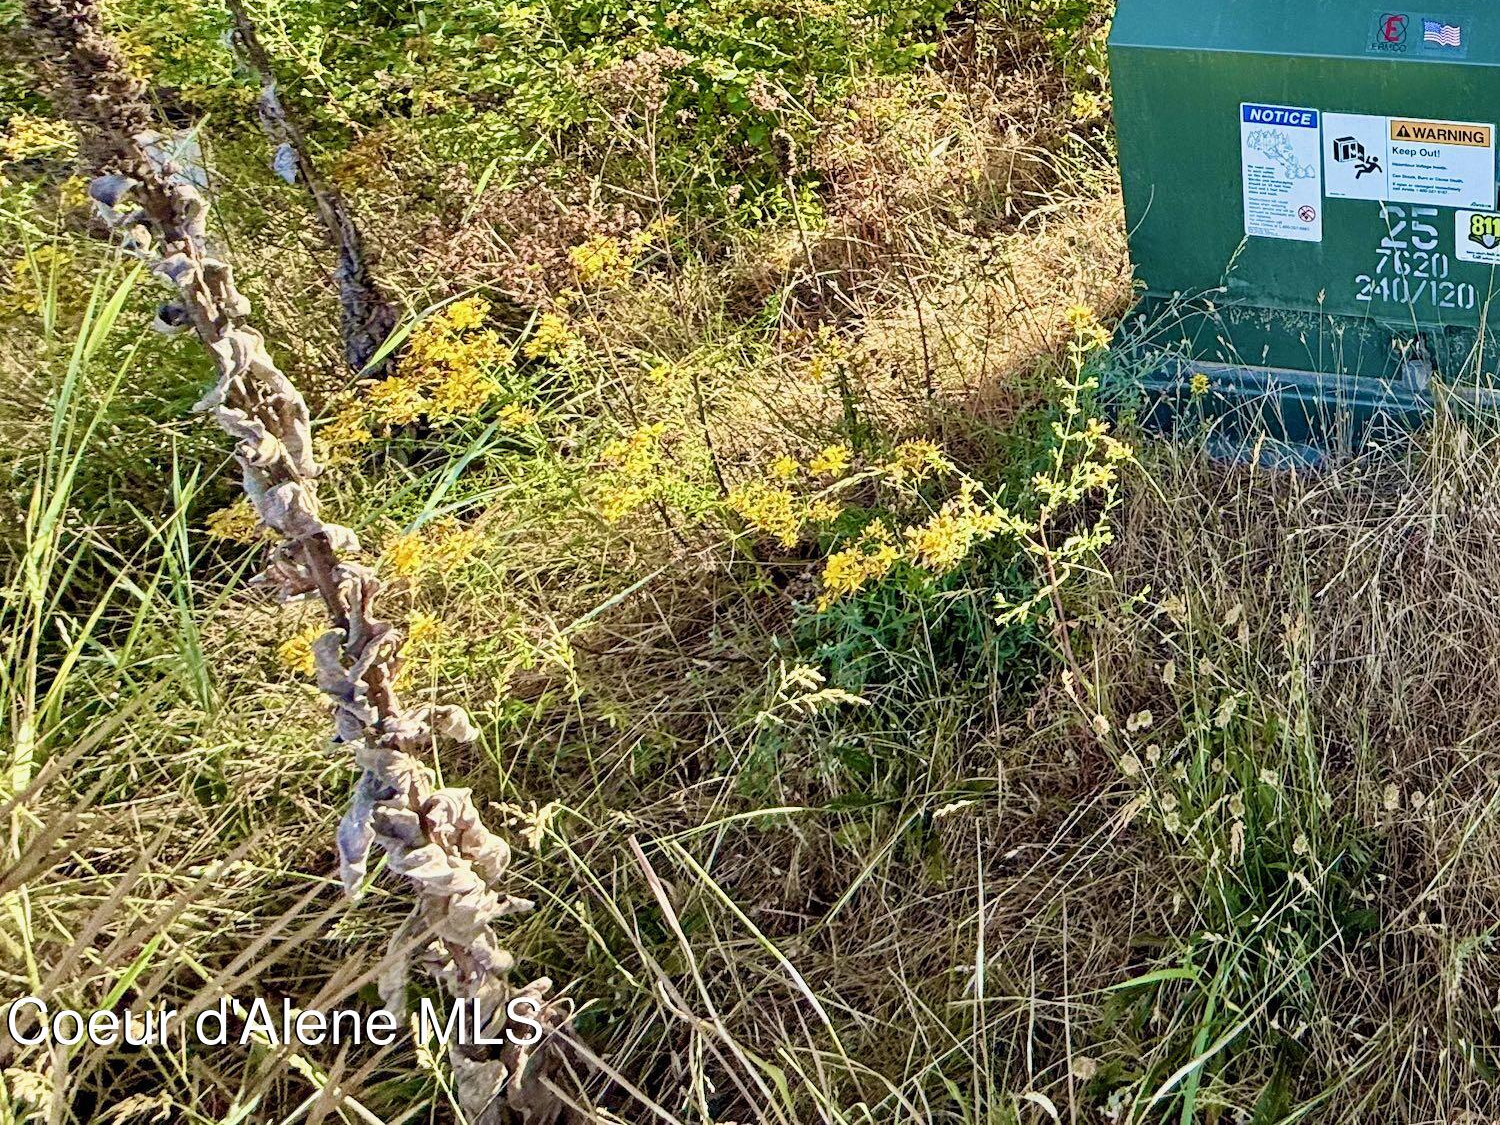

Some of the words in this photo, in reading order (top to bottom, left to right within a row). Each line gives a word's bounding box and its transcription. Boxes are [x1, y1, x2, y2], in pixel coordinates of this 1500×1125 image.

[1249, 108, 1312, 125] NOTICE
[1412, 127, 1485, 144] WARNING
[1392, 146, 1417, 157] Keep
[1419, 148, 1440, 158] Out!
[1379, 205, 1439, 251] 25
[1375, 248, 1448, 279] 7620
[1355, 274, 1475, 310] 240/120
